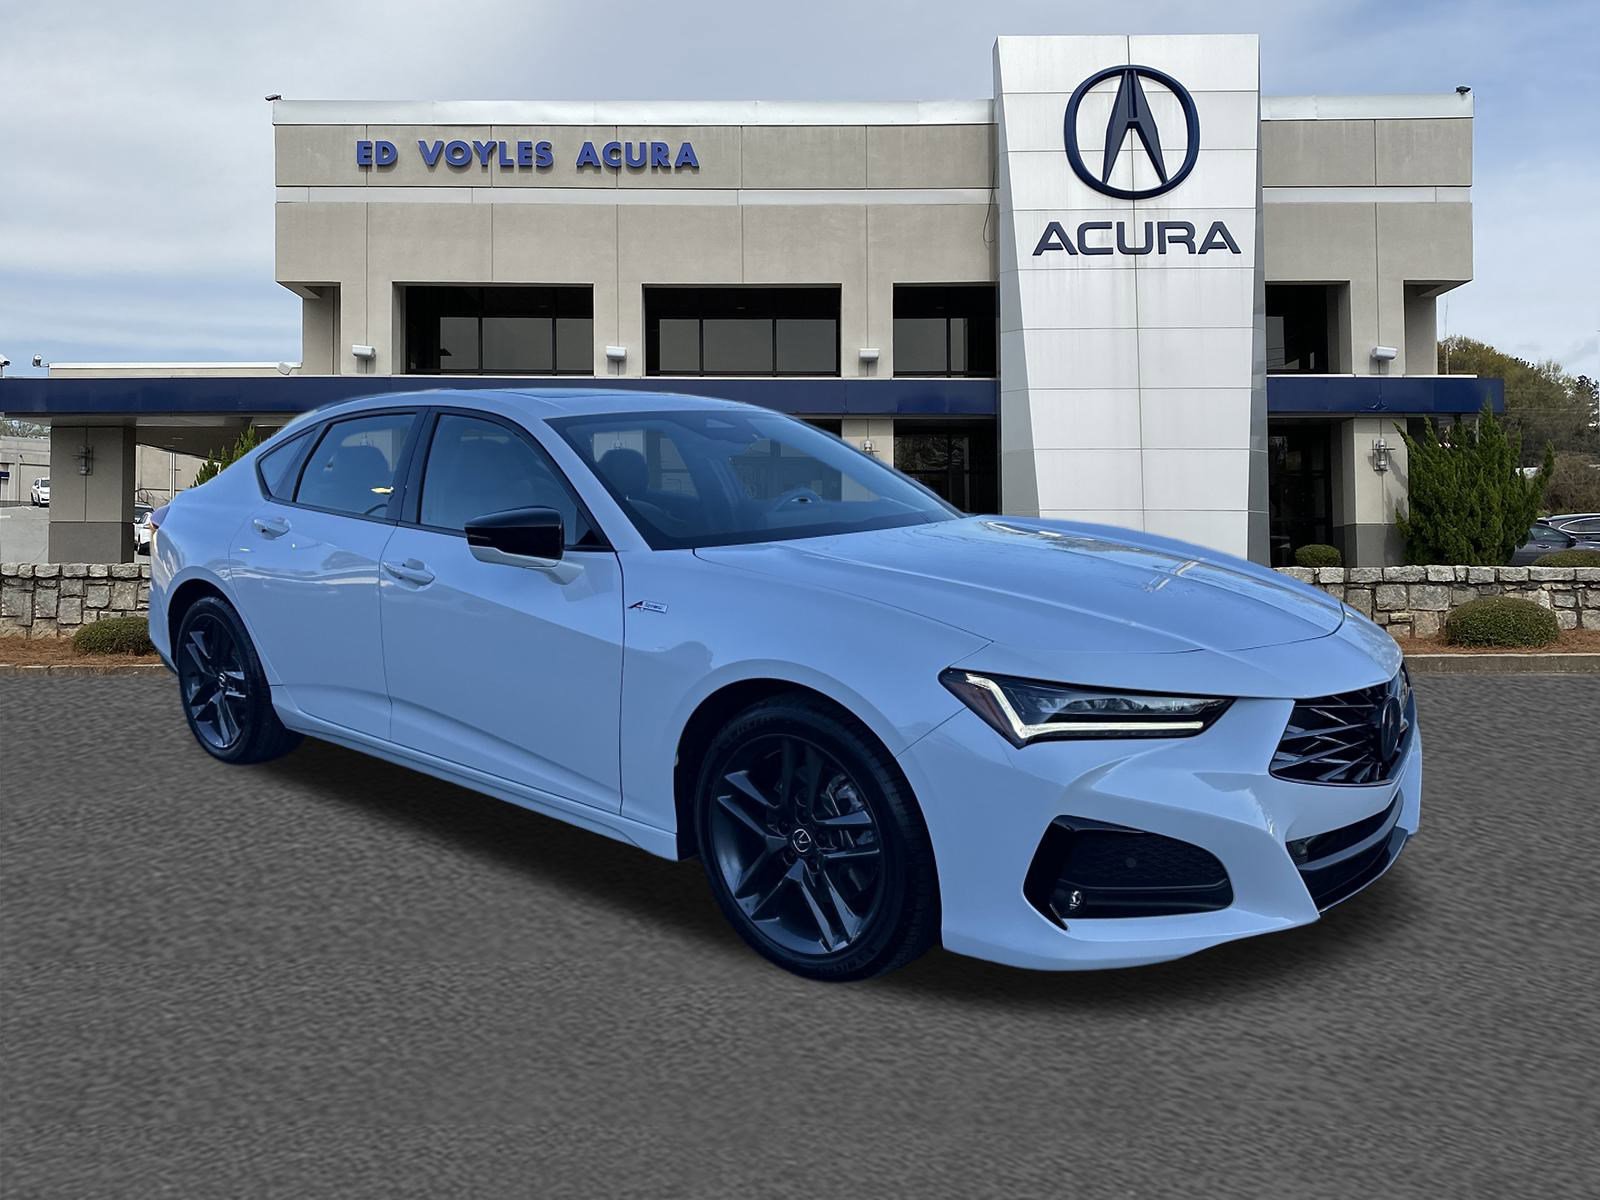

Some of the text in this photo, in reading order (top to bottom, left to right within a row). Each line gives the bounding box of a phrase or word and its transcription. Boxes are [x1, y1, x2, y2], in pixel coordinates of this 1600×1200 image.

[356, 140, 700, 169] ED VOYLES ACURA
[1032, 221, 1242, 256] ACURA
